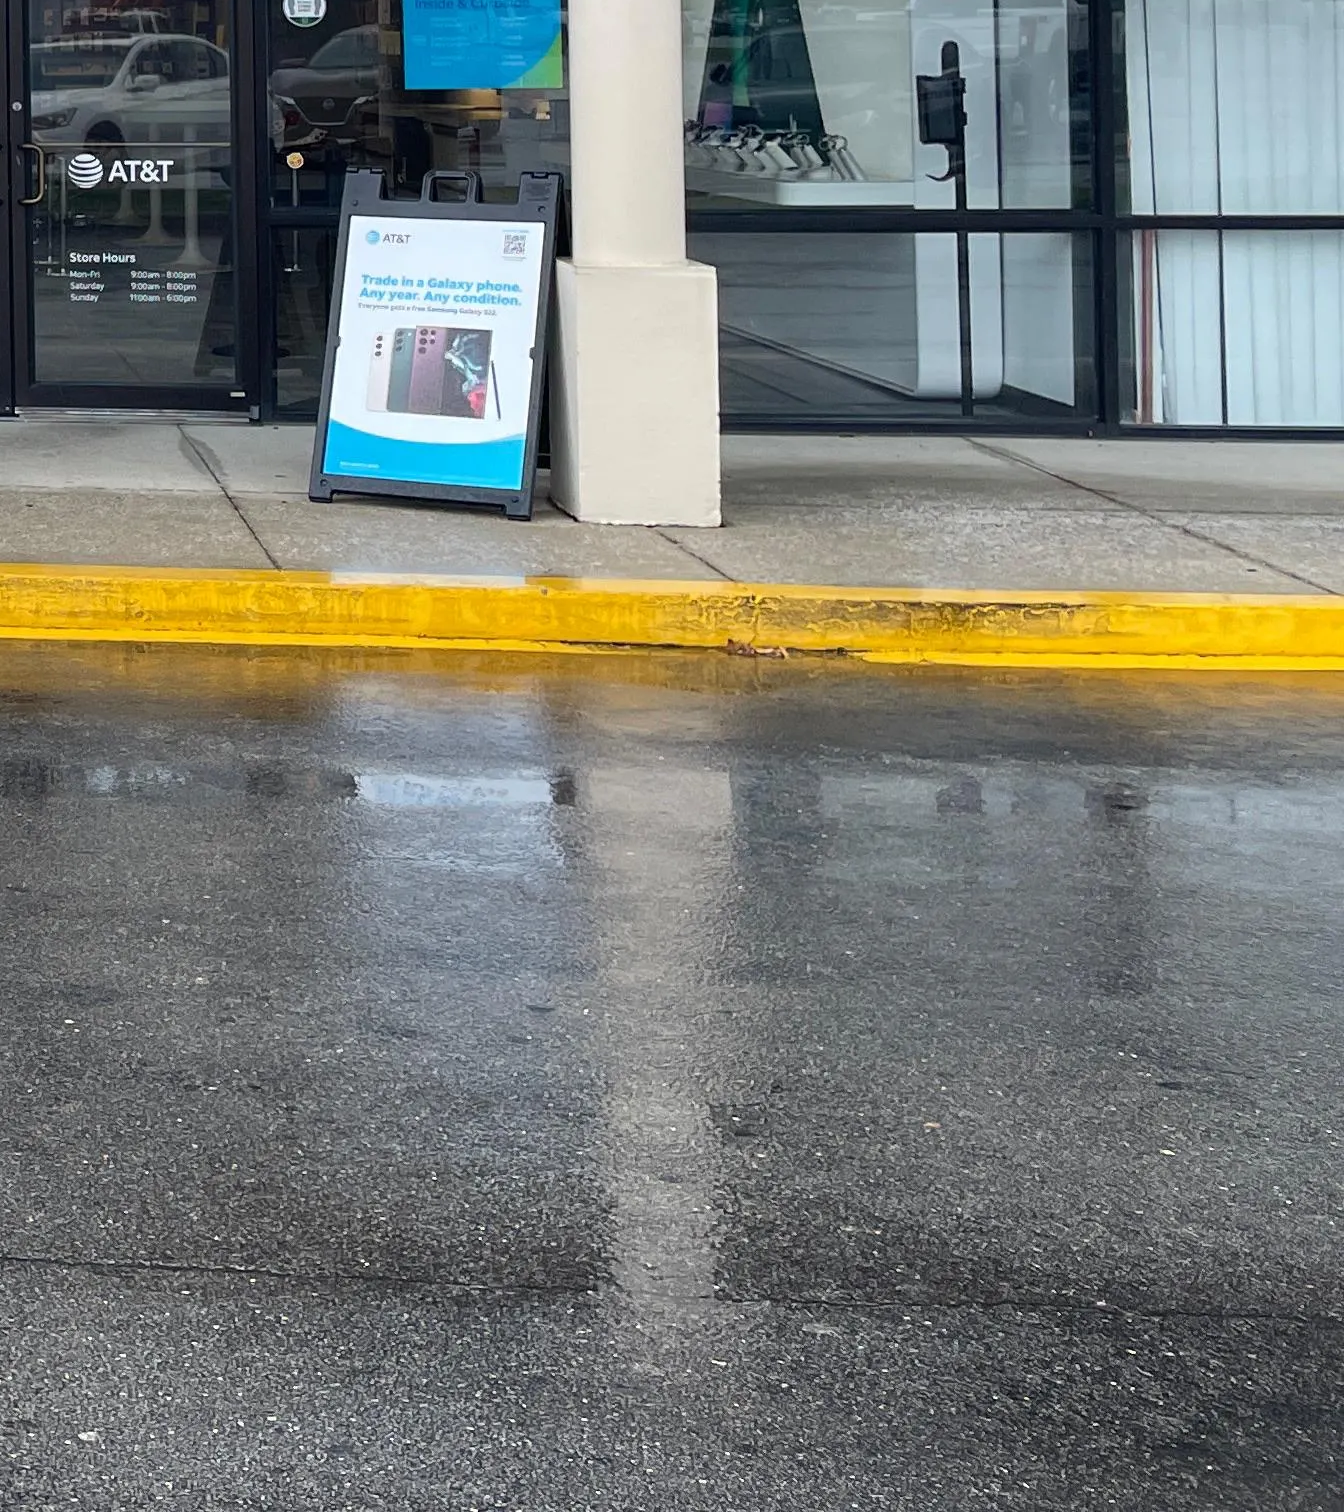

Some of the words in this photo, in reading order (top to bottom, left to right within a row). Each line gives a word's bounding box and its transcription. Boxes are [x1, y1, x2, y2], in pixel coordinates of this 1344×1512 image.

[108, 160, 174, 183] AT&T
[382, 233, 411, 244] AT&T
[69, 252, 100, 263] Store
[102, 252, 136, 263] Hours
[69, 282, 105, 291] Saturday
[361, 274, 398, 287] Trade
[401, 276, 414, 287] in
[416, 279, 424, 288] a
[427, 277, 473, 292] Galaxy
[477, 280, 523, 294] phone.
[70, 294, 99, 303] Sunday
[359, 288, 386, 301] Any
[388, 290, 420, 301] year.
[424, 291, 450, 304] Any
[453, 292, 522, 306] condition.
